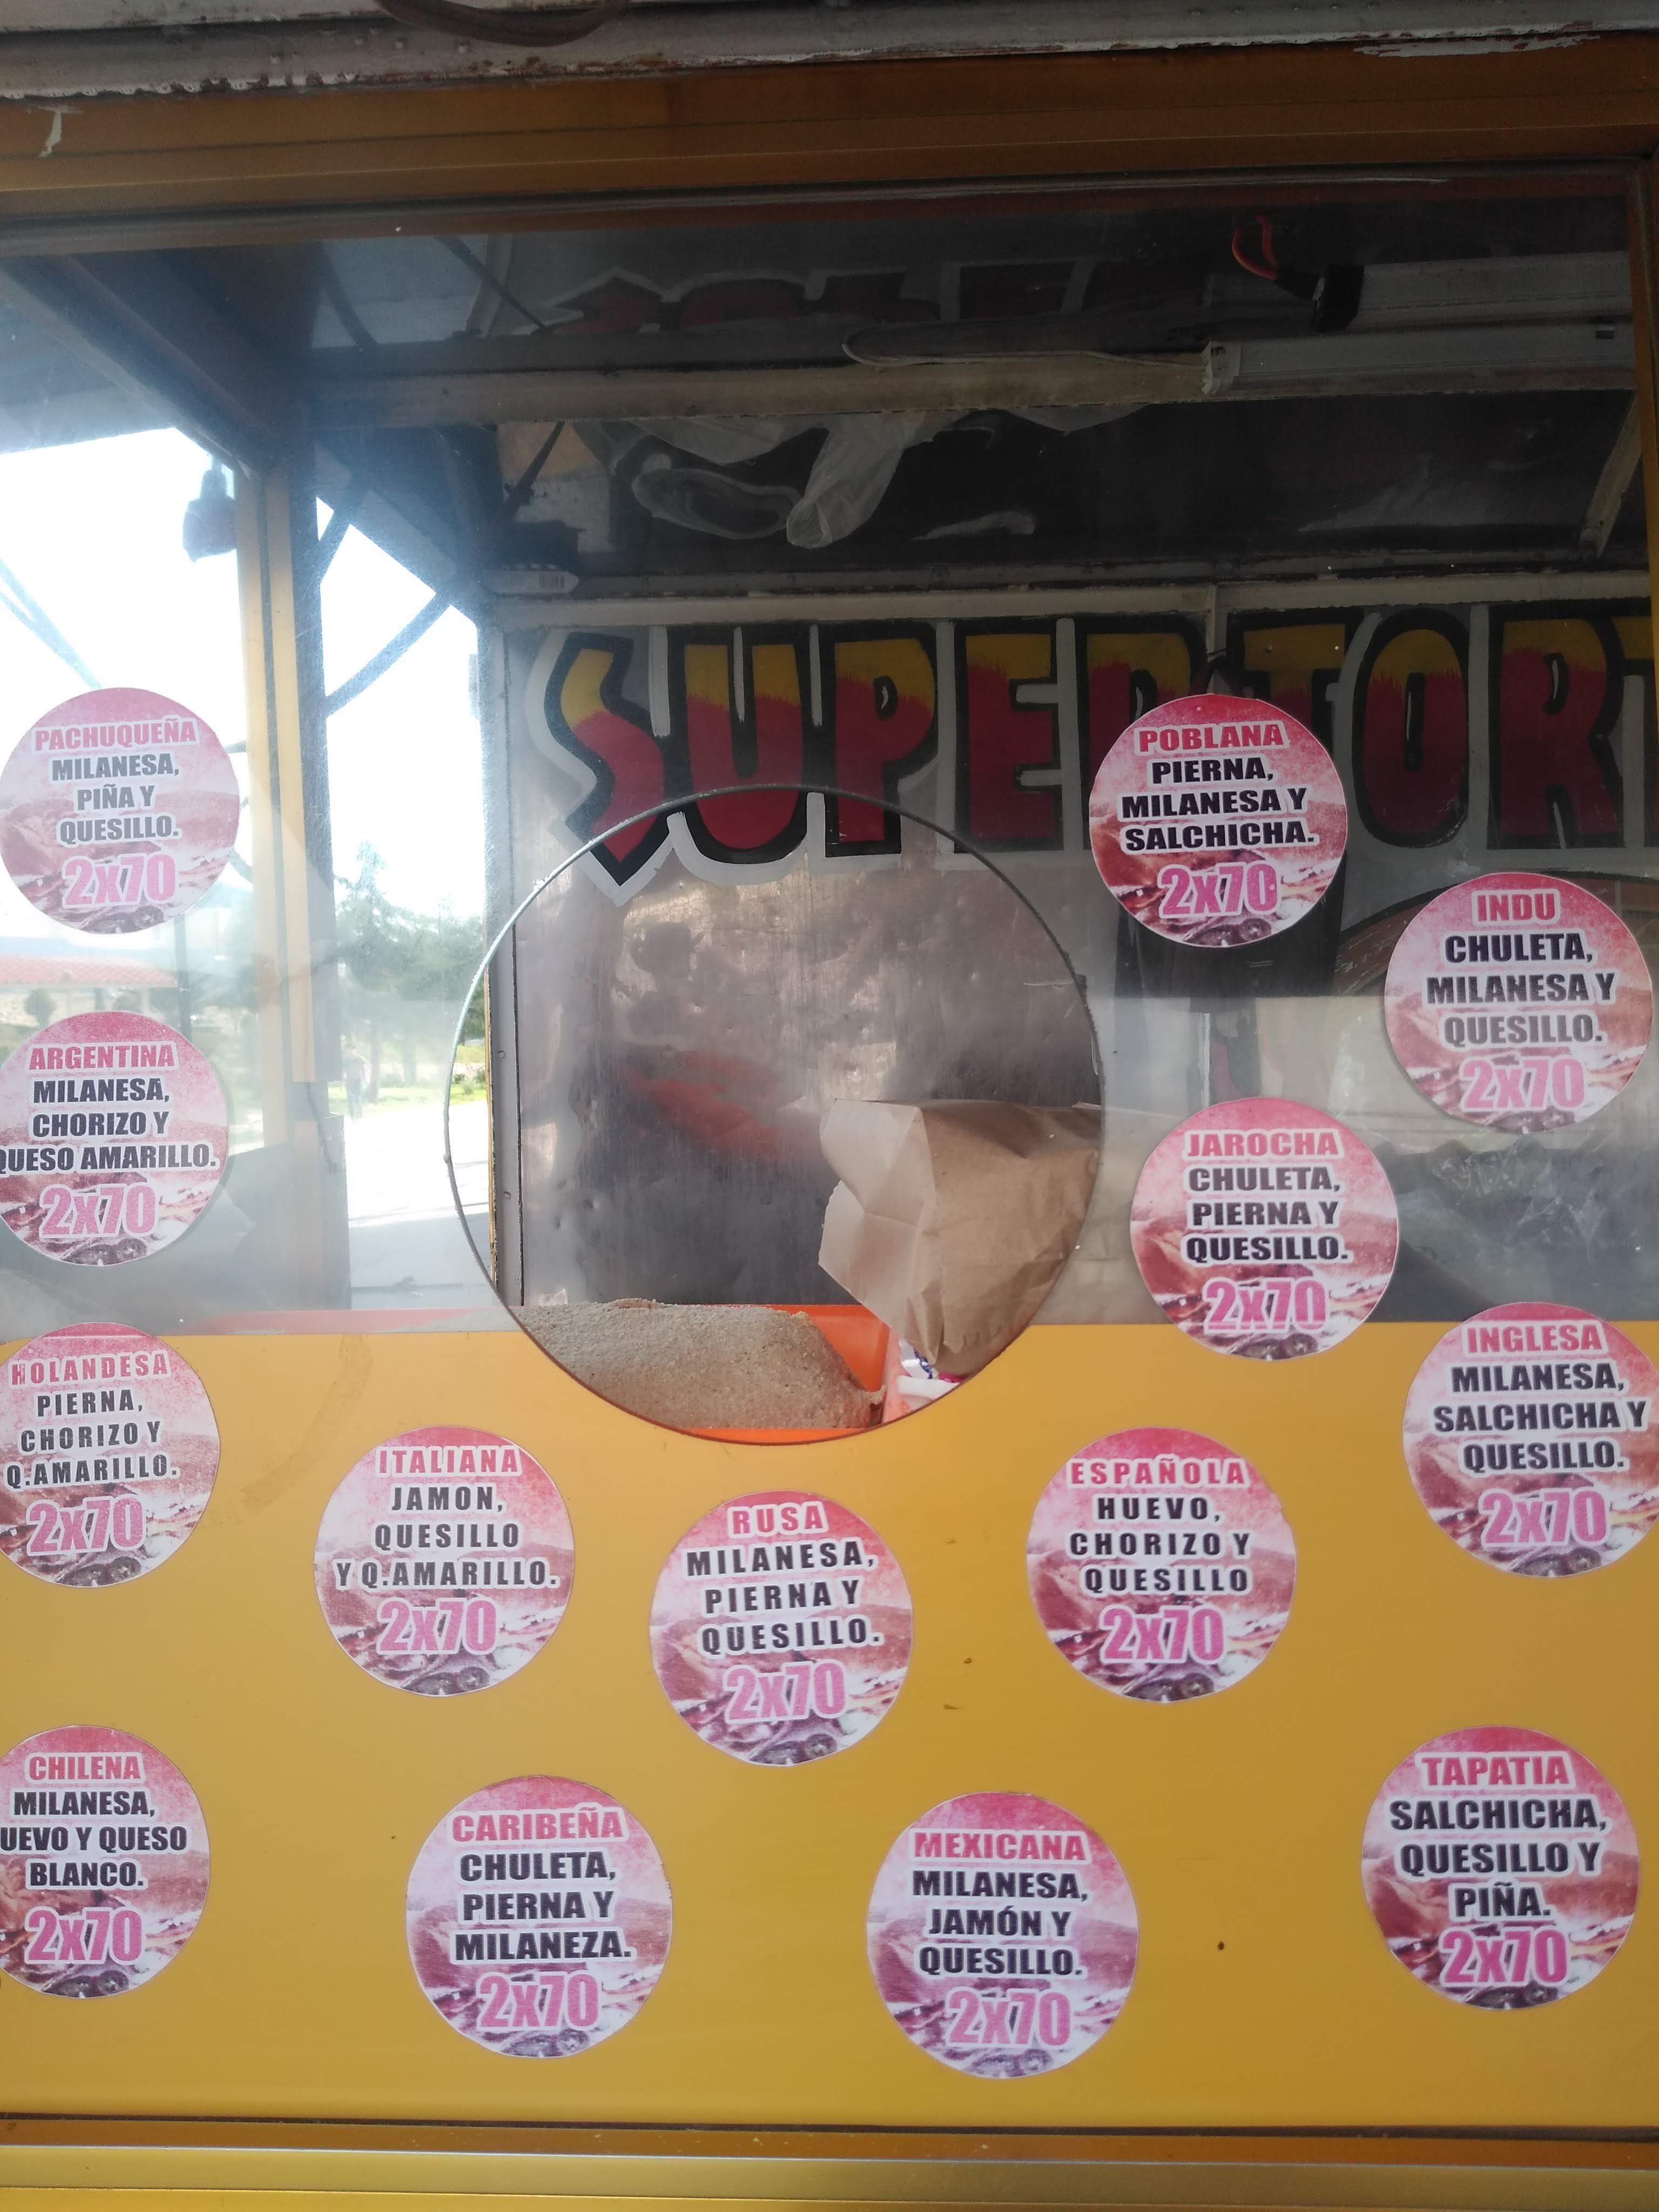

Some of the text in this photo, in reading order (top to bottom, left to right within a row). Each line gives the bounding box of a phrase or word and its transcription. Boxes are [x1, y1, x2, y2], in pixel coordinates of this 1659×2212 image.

[35, 718, 197, 751] PACHUQUEÑA
[1139, 724, 1284, 752] POBLANA
[52, 753, 179, 781] MILANESA,
[1152, 757, 1273, 784] PIERNA,
[77, 784, 154, 810] PIÑA Y
[1122, 787, 1307, 818] MILANESA Y
[59, 815, 179, 845] QUESILLO.
[1125, 821, 1314, 851] SALCHICHA.
[1476, 893, 1556, 922] INDU
[1445, 933, 1593, 963] CHULETA,
[1426, 973, 1615, 1004] MILANESA Y
[1444, 1014, 1602, 1047] QUESILLO.
[29, 1045, 175, 1070] ARGENTINA
[33, 1078, 170, 1103] MILANESA,
[32, 1111, 169, 1137] CHORIZO Y
[80, 1144, 217, 1170] AMARILLO.
[1188, 1132, 1338, 1156] JAROCHA
[1188, 1166, 1340, 1192] CHULETA,
[1192, 1201, 1338, 1225] PIERNA Y
[1187, 1236, 1347, 1263] QUESILLO.
[1467, 1324, 1603, 1353] INGLESA
[11, 1353, 167, 1385] HOLANDESA
[1451, 1363, 1624, 1392] MILANESA,
[37, 1389, 143, 1417] PIERNA,
[1433, 1400, 1647, 1432] SALCHICHA Y
[21, 1421, 160, 1452] CHORIZO Y
[379, 1449, 518, 1473] ITALIANA
[1071, 1458, 1245, 1484] ESPAÑOLA
[1463, 1440, 1624, 1473] QUESILLO.
[6, 1454, 177, 1489] Q.AMARILLO.
[392, 1486, 503, 1513] JAMON,
[1097, 1497, 1220, 1522] HUEVO,
[732, 1505, 823, 1535] RUSA
[375, 1523, 519, 1551] QUESILLO
[1069, 1533, 1251, 1555] CHORIZO Y
[686, 1541, 875, 1576] MILANESA,
[336, 1561, 556, 1588] Y Q.AMARILLO.
[1085, 1568, 1248, 1593] QUESILLO
[705, 1579, 859, 1614] PIERNA Y
[702, 1618, 880, 1655] QUESILLO.
[29, 1756, 141, 1781] CHILENA
[1421, 1755, 1569, 1786] TAPATIA
[14, 1791, 155, 1817] MILANESA,
[1390, 1799, 1607, 1831] SALCHICHA,
[452, 1806, 624, 1842] CARIBEÑA
[0, 1826, 187, 1853] UEVO Y QUESO
[914, 1832, 1086, 1860] MEXICANA
[30, 1862, 144, 1886] BLANCO.
[460, 1851, 616, 1881] CHULETA,
[1400, 1842, 1601, 1877] QUESILLO Y
[912, 1870, 1088, 1901] MILANESA,
[1454, 1881, 1551, 1917] PIÑA.
[463, 1891, 615, 1920] PIERNA Y
[929, 1906, 1071, 1937] JAMÓN Y
[455, 1931, 631, 1960] MILANEZA.
[919, 1946, 1082, 1975] QUESILLO.
